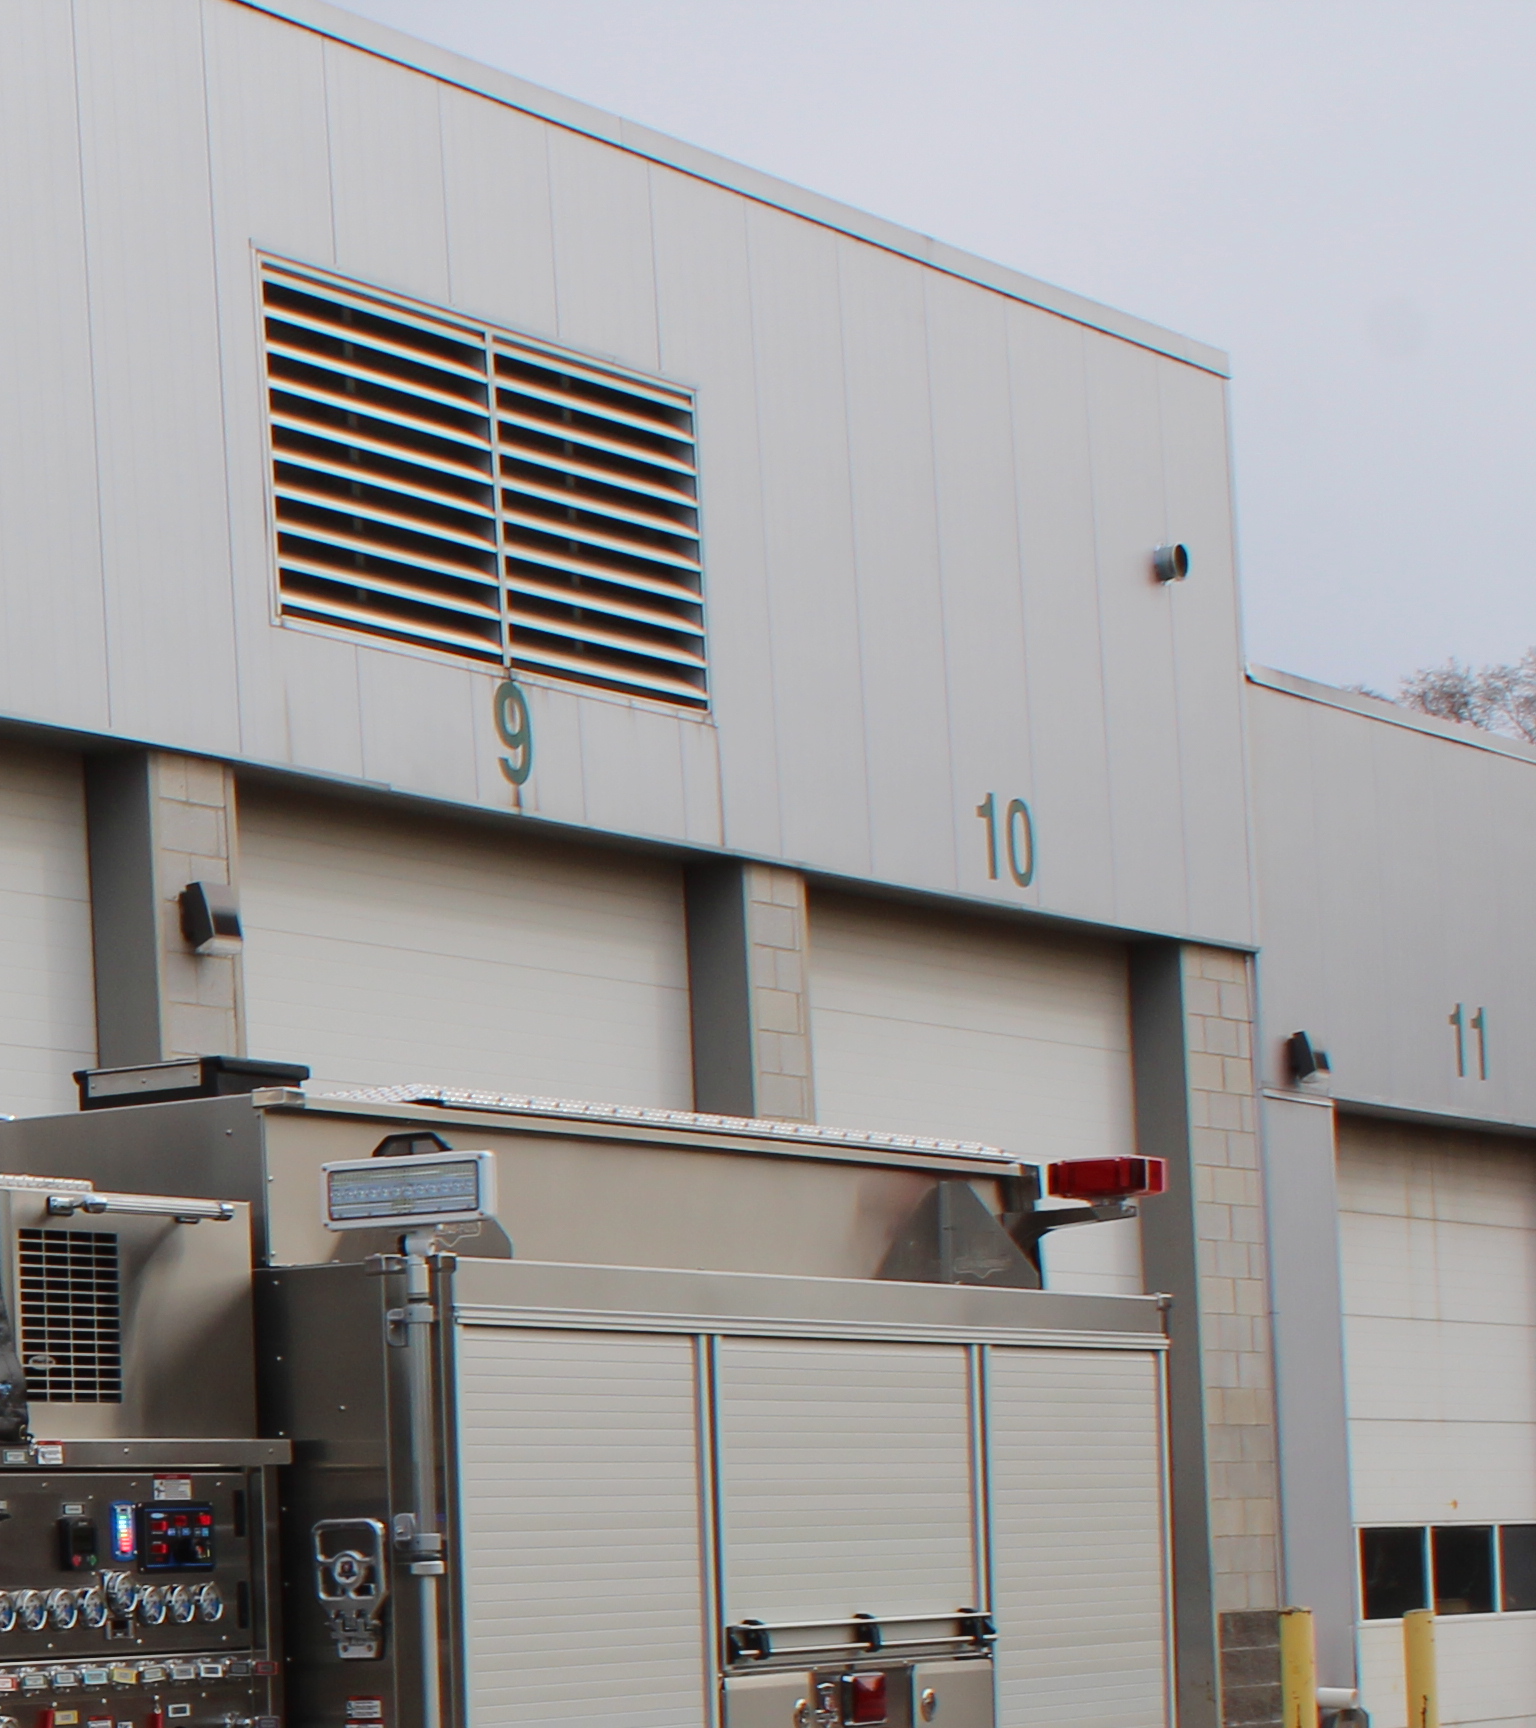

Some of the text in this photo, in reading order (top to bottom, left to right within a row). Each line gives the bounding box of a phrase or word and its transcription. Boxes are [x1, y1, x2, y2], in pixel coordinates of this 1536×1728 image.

[494, 681, 532, 786] 9
[976, 792, 1035, 888] 10
[1448, 1003, 1488, 1081] 11
